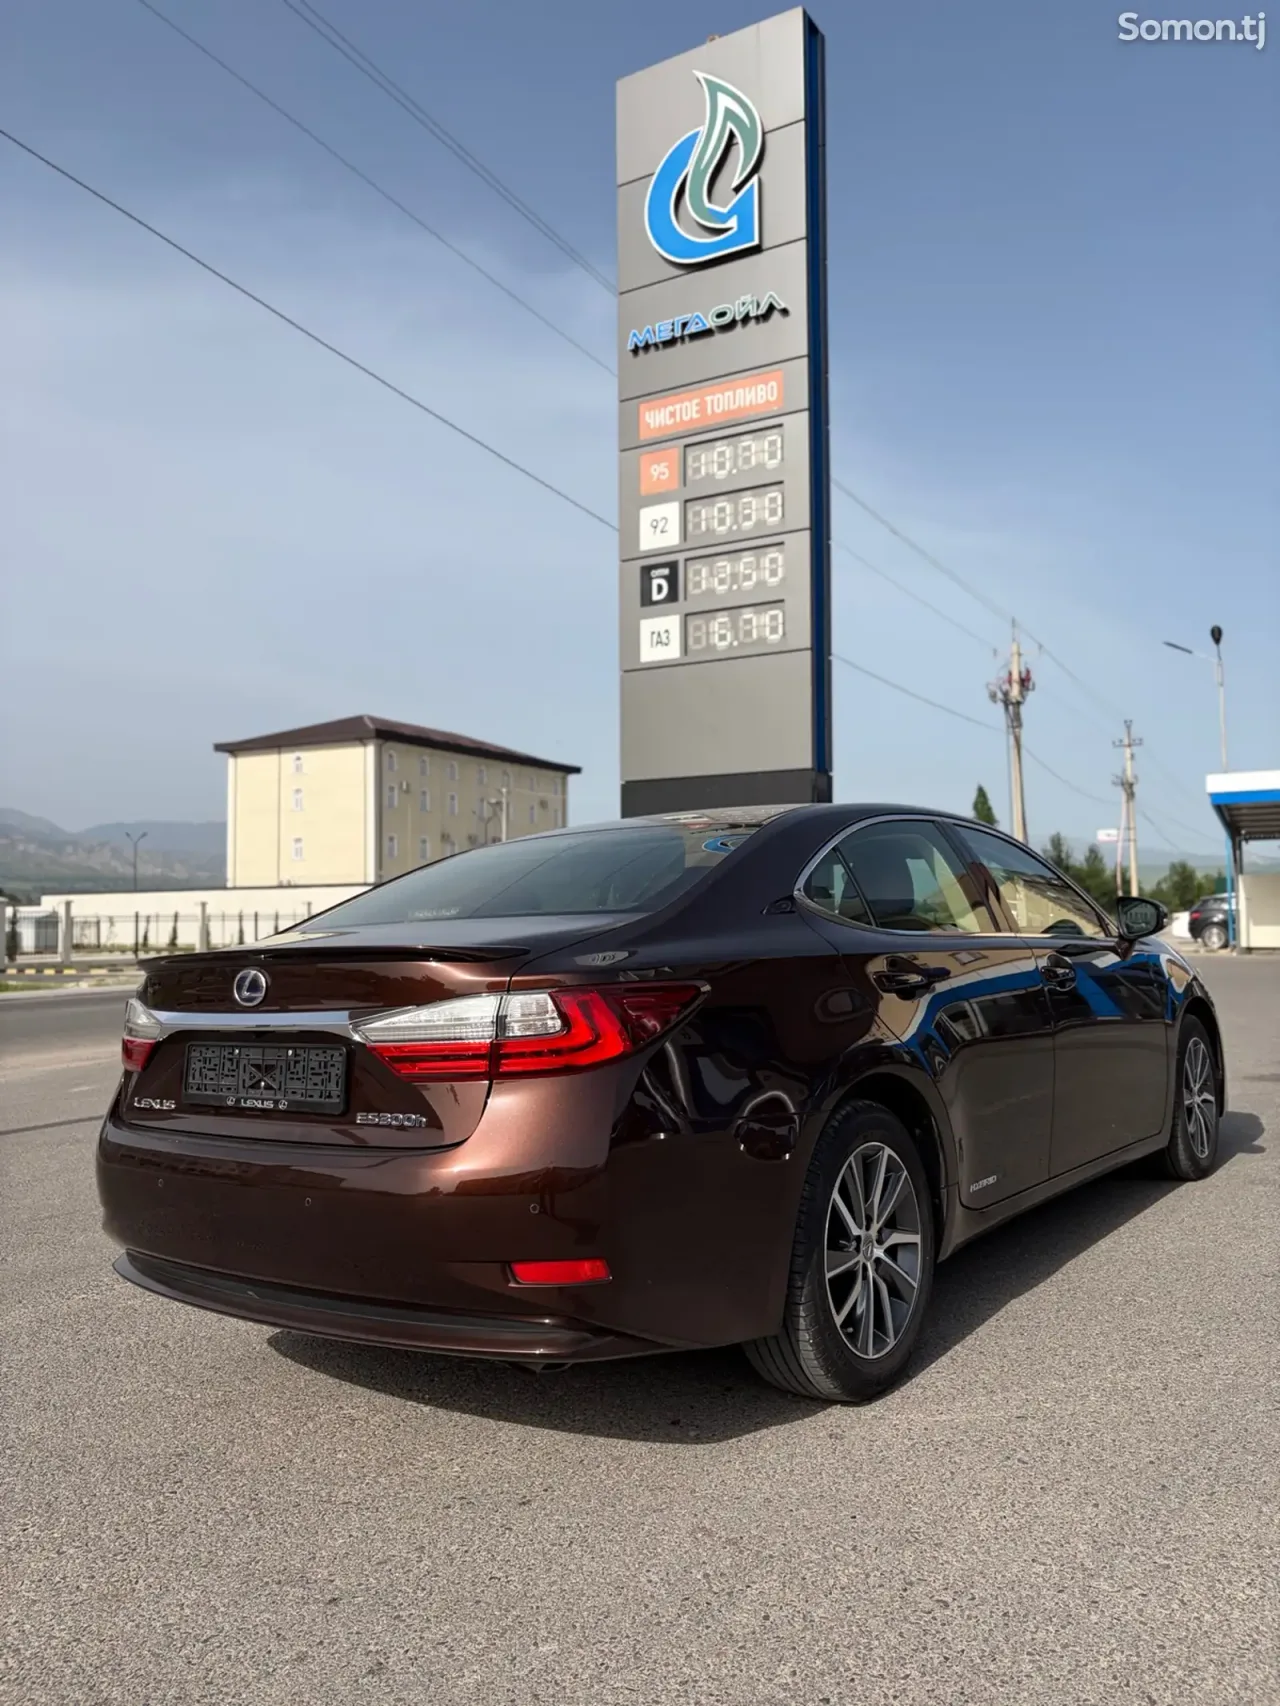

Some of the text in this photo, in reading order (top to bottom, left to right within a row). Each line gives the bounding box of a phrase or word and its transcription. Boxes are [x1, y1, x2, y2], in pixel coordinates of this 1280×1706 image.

[627, 291, 786, 350] МЕГАОЙЛ
[645, 381, 778, 429] ЧИСТОЕ ТОПЛИВО
[650, 462, 670, 481] 95
[650, 517, 669, 536] 92
[652, 578, 669, 601] D
[650, 629, 670, 648] ГАЗ
[134, 1097, 177, 1110] LEXUS
[241, 1099, 274, 1109] LEXUS
[356, 1112, 427, 1128] ES300h
